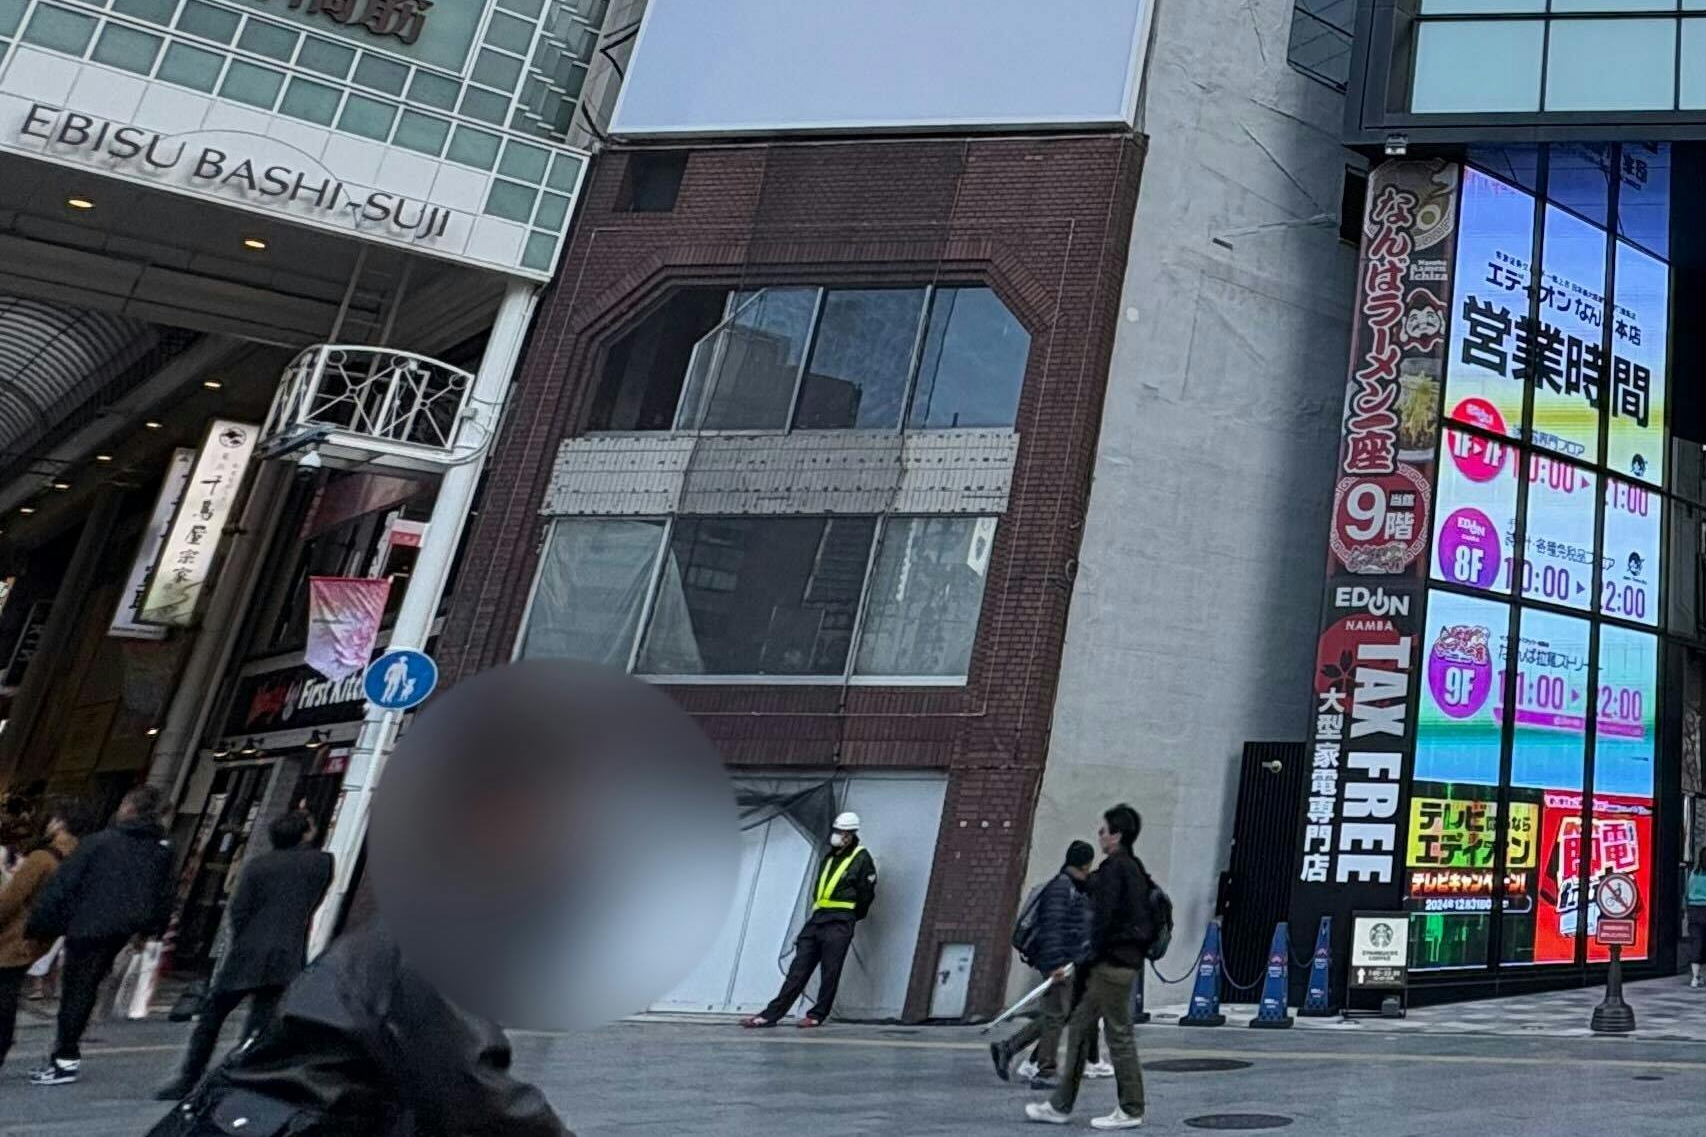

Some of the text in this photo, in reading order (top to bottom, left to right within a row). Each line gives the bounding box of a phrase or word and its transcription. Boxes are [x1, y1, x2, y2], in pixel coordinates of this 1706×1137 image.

[19, 103, 451, 241] EBISU BASHI-SUJI
[1344, 185, 1418, 474] なんばラーメン一座
[1462, 295, 1652, 430] 営業時間
[1335, 586, 1410, 617] EDION
[1345, 620, 1394, 632] NAMBA
[1454, 545, 1484, 583] 8F
[1445, 666, 1475, 706] 9F
[1300, 686, 1347, 883] 大型家電専門店
[1336, 637, 1414, 884] TAX FREE
